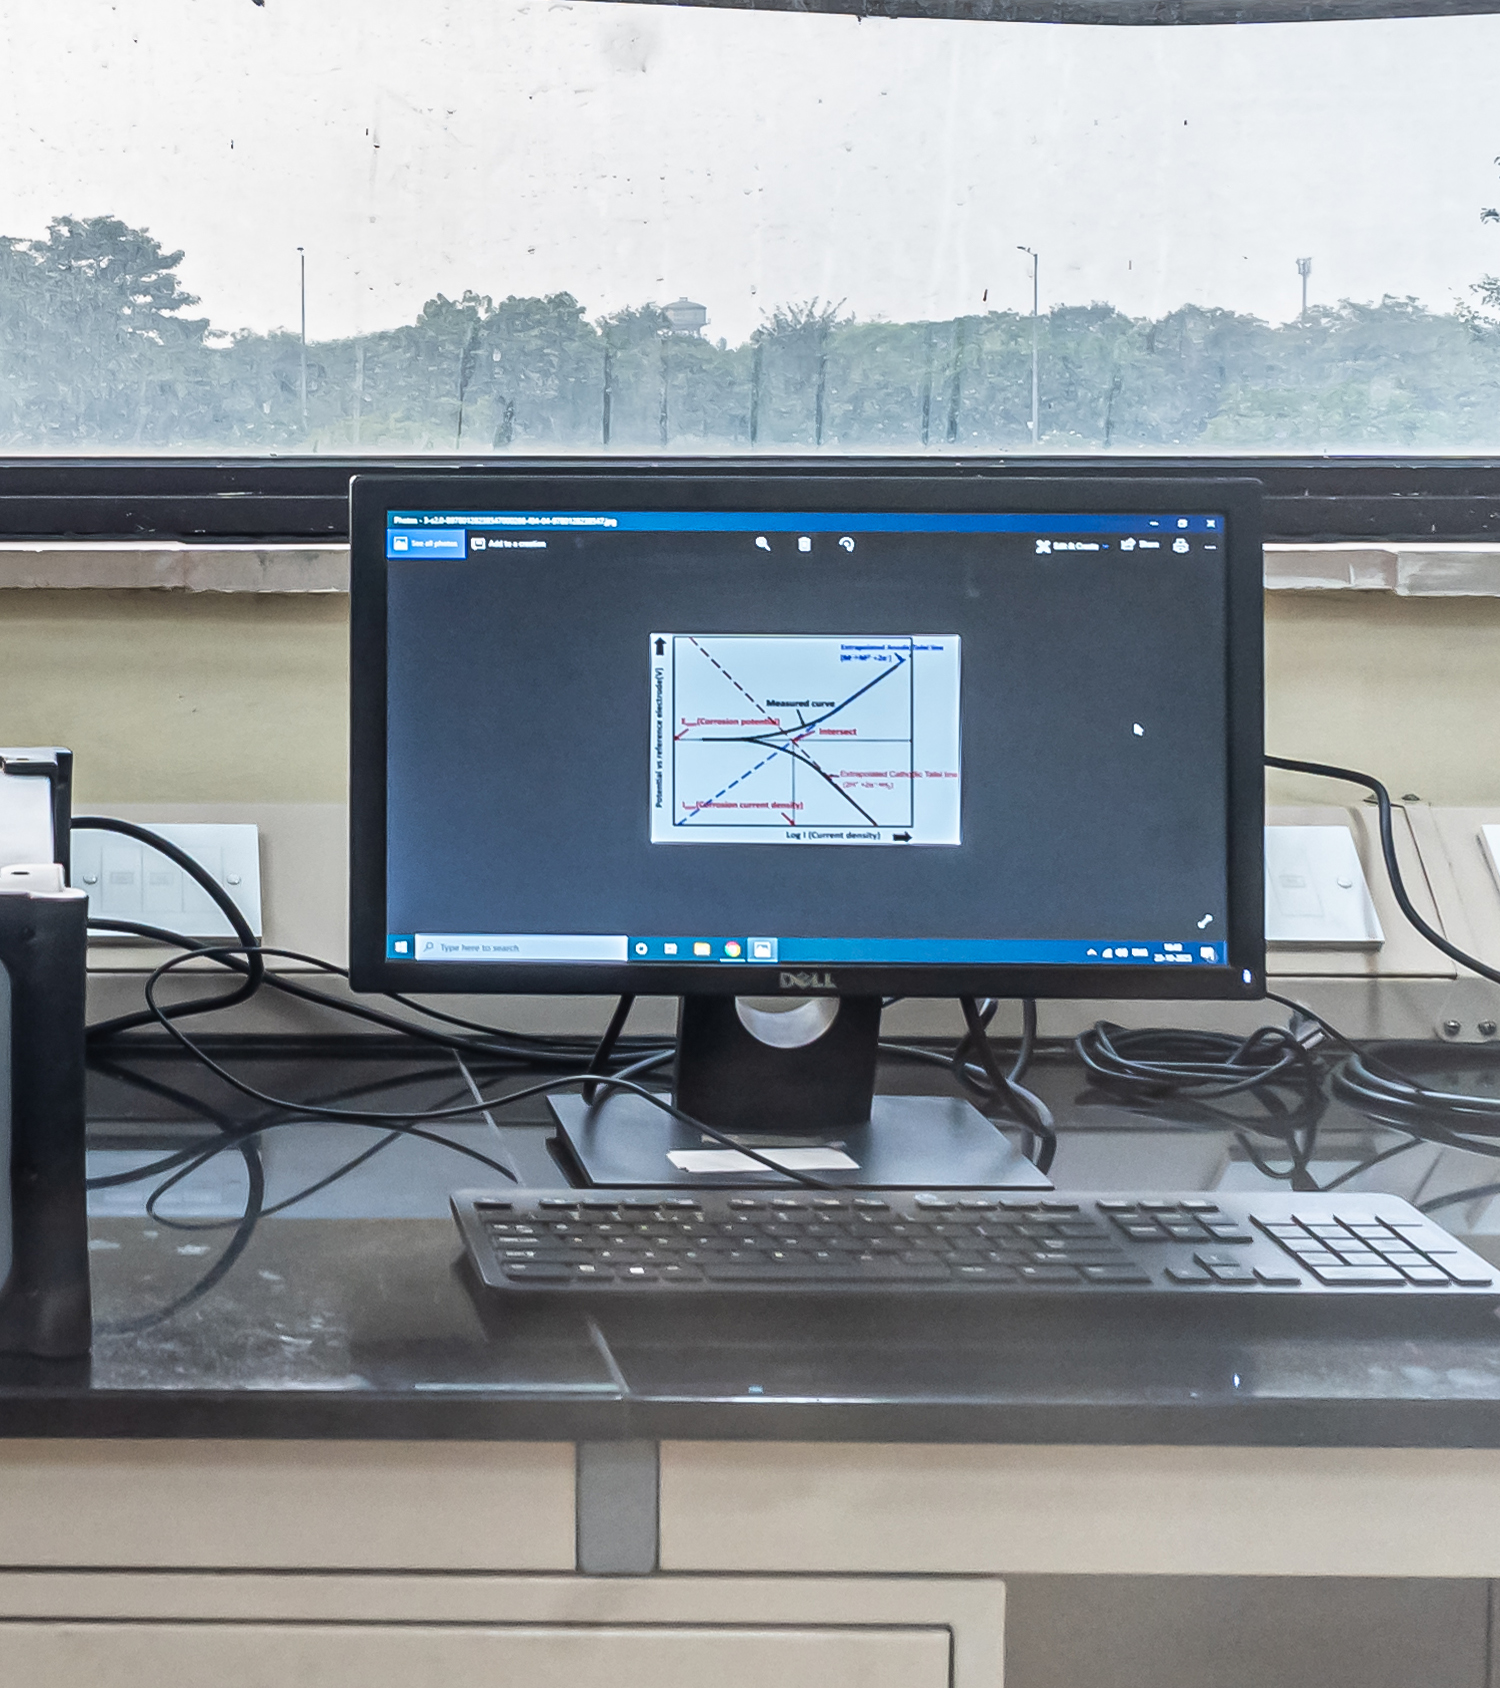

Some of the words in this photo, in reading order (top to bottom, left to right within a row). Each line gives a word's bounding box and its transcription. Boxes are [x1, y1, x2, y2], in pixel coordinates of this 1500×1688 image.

[766, 700, 810, 708] Measured
[819, 727, 857, 736] Intersect
[739, 801, 769, 809] current
[786, 831, 800, 840] Log
[808, 831, 843, 839] (Current
[845, 831, 881, 840] density)
[780, 972, 838, 989] DELL
